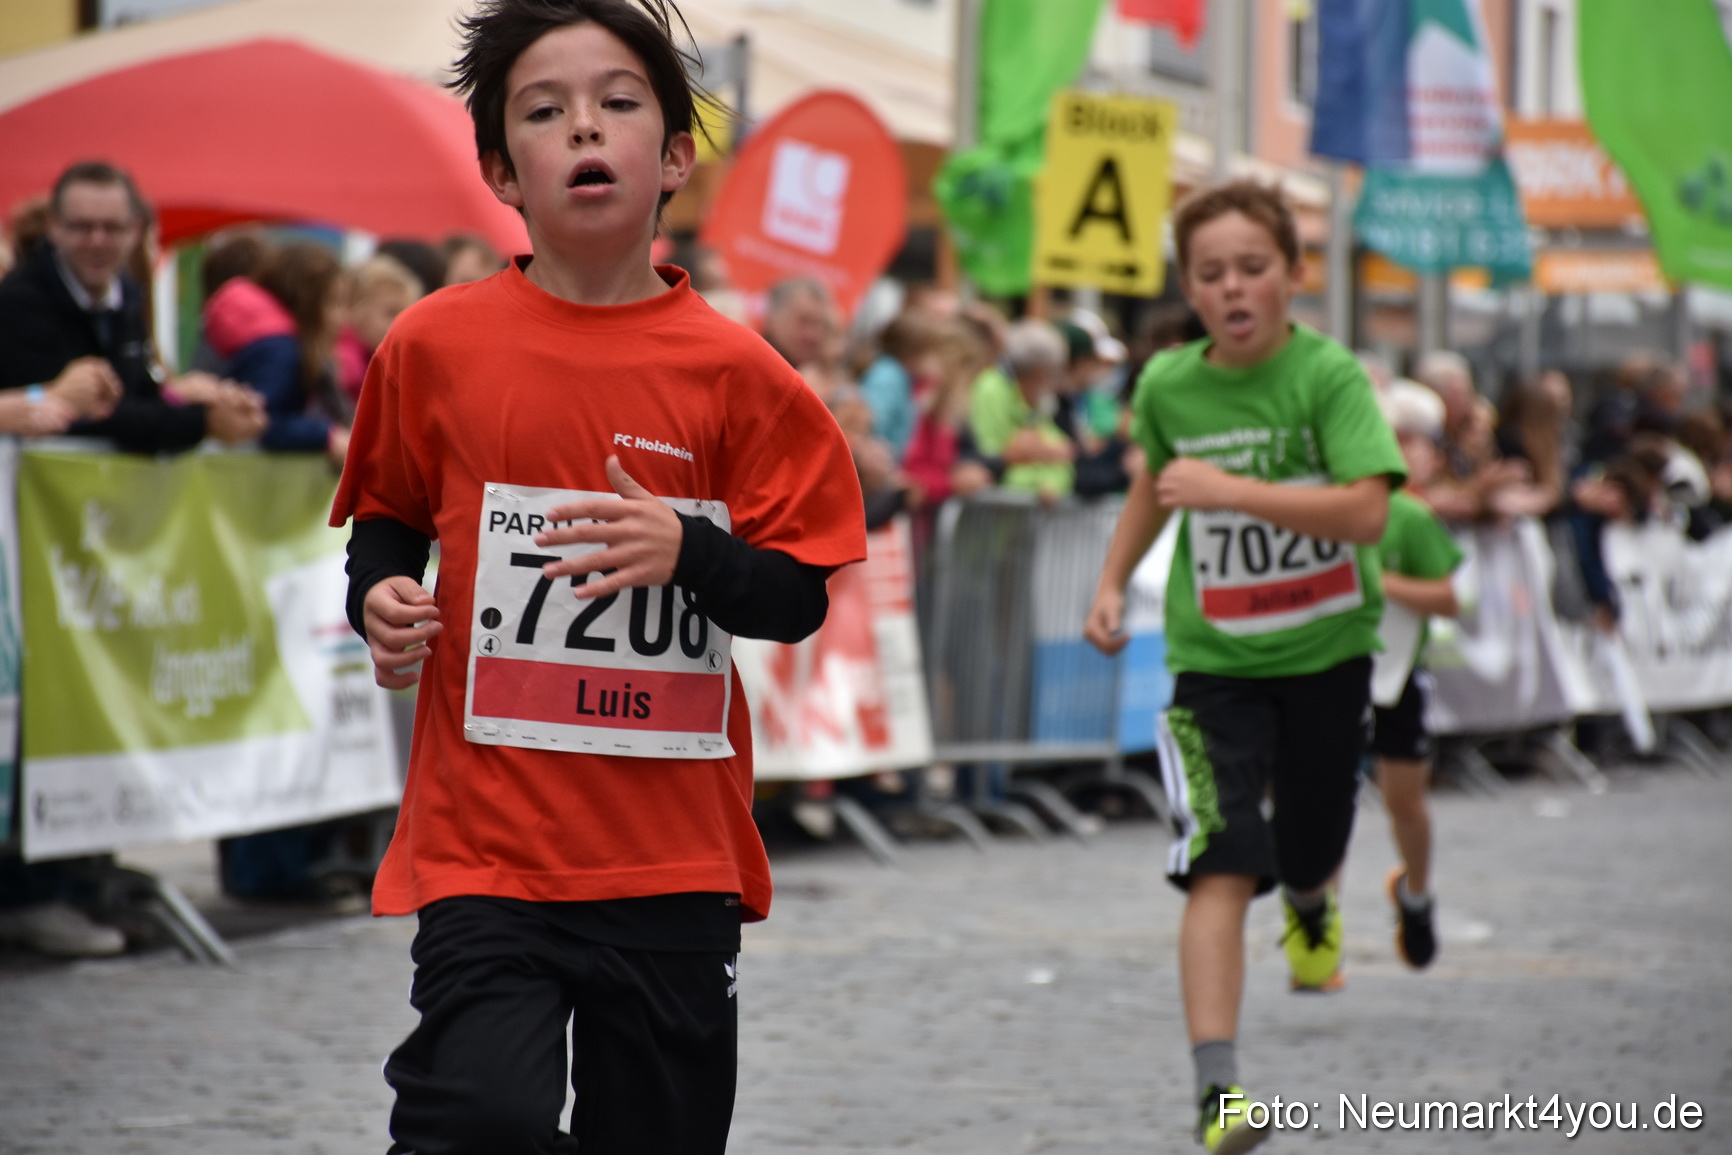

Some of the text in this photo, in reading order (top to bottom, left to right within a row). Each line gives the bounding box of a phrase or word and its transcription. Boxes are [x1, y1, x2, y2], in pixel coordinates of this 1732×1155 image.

[1069, 157, 1132, 243] A
[613, 433, 633, 447] FC
[510, 552, 708, 659] 7208
[576, 679, 651, 719] Luis
